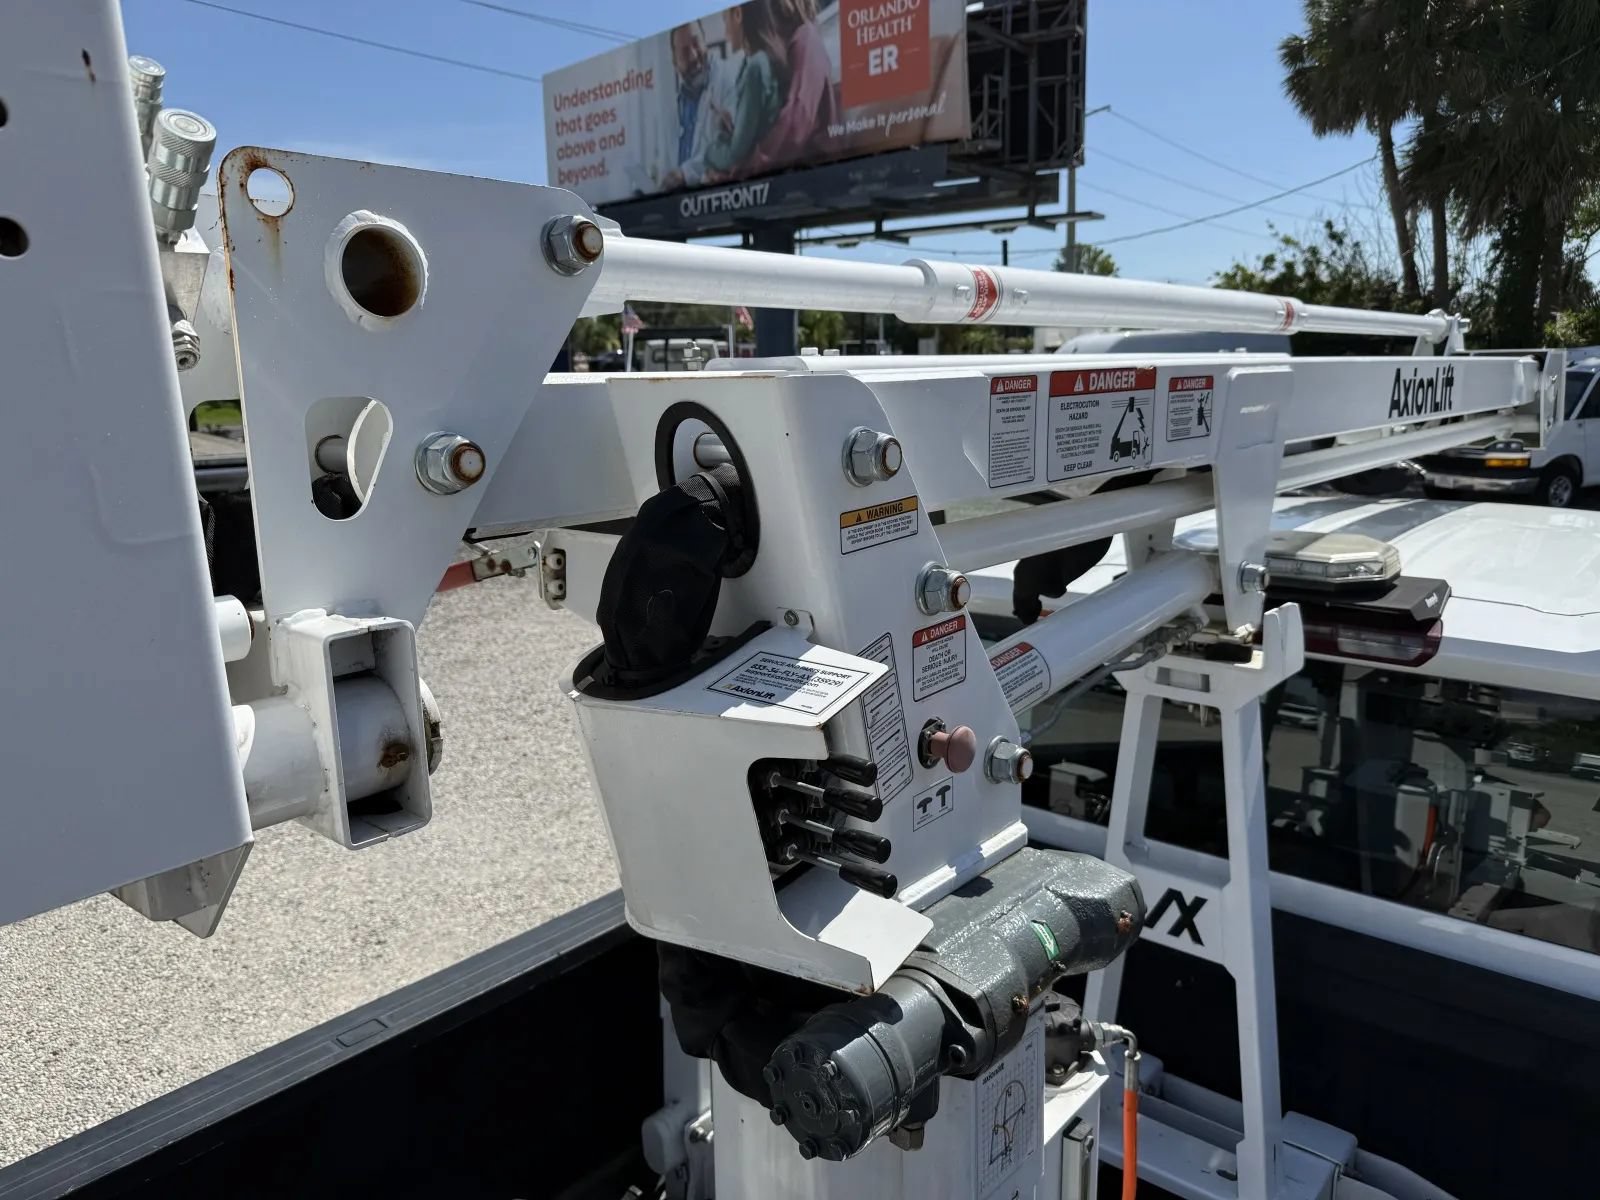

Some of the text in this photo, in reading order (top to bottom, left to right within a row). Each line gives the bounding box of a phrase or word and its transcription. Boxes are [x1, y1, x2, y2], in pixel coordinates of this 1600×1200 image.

[848, 0, 920, 28] ORLANDO
[857, 15, 912, 46] HEALTH
[869, 44, 898, 76] ER
[554, 68, 654, 112] Understanding
[556, 108, 617, 136] that goes
[828, 123, 844, 138] We
[846, 118, 875, 134] Make
[885, 90, 946, 137] personal
[556, 126, 625, 160] above and
[558, 156, 609, 186] beyond.
[1004, 380, 1032, 390] DANGER
[1088, 370, 1136, 391] DANGER
[1183, 378, 1205, 390] DANGER
[1388, 363, 1454, 418] AxionLift
[1060, 400, 1100, 410] ELECTROCUTION
[1068, 412, 1088, 420] HAZARD
[1064, 460, 1092, 472] KEEP CLEAR
[866, 502, 904, 520] WARNING
[930, 620, 958, 638] DANGER
[922, 660, 941, 674] SERIOUS
[944, 654, 958, 664] INJURY
[929, 652, 944, 663] DEATH
[760, 658, 786, 666] SERVICE
[820, 670, 852, 679] SUPPORT
[730, 686, 775, 699] AxionLift
